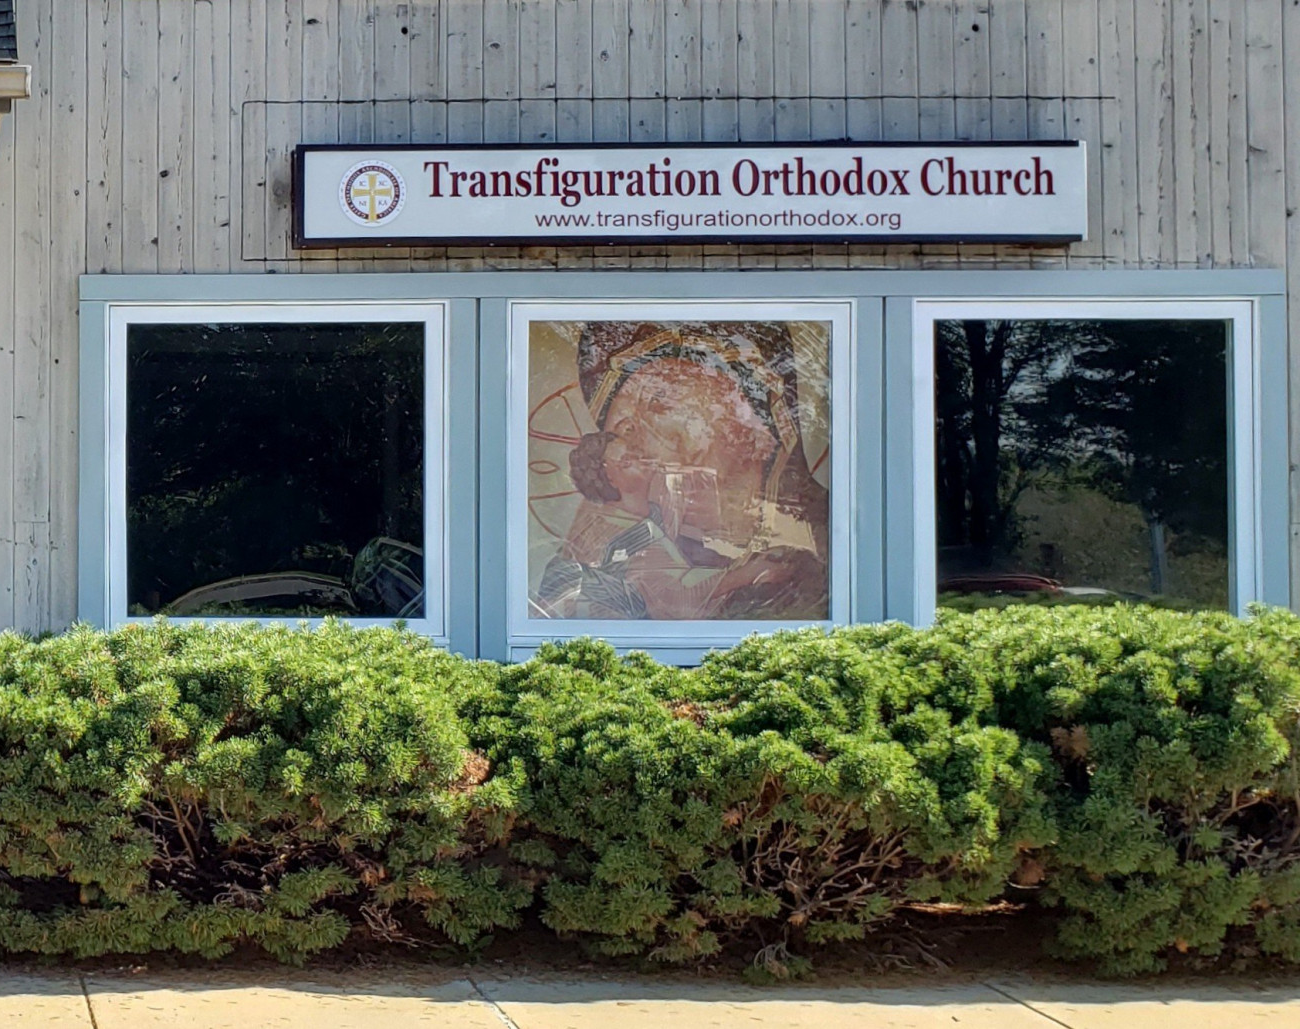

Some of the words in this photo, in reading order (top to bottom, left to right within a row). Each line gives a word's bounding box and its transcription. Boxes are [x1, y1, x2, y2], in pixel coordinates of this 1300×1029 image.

[423, 157, 722, 206] Transfiguration
[732, 156, 911, 197] Orthodox
[920, 156, 1056, 197] Church
[534, 209, 903, 232] www.transfigurationorthodox.org
